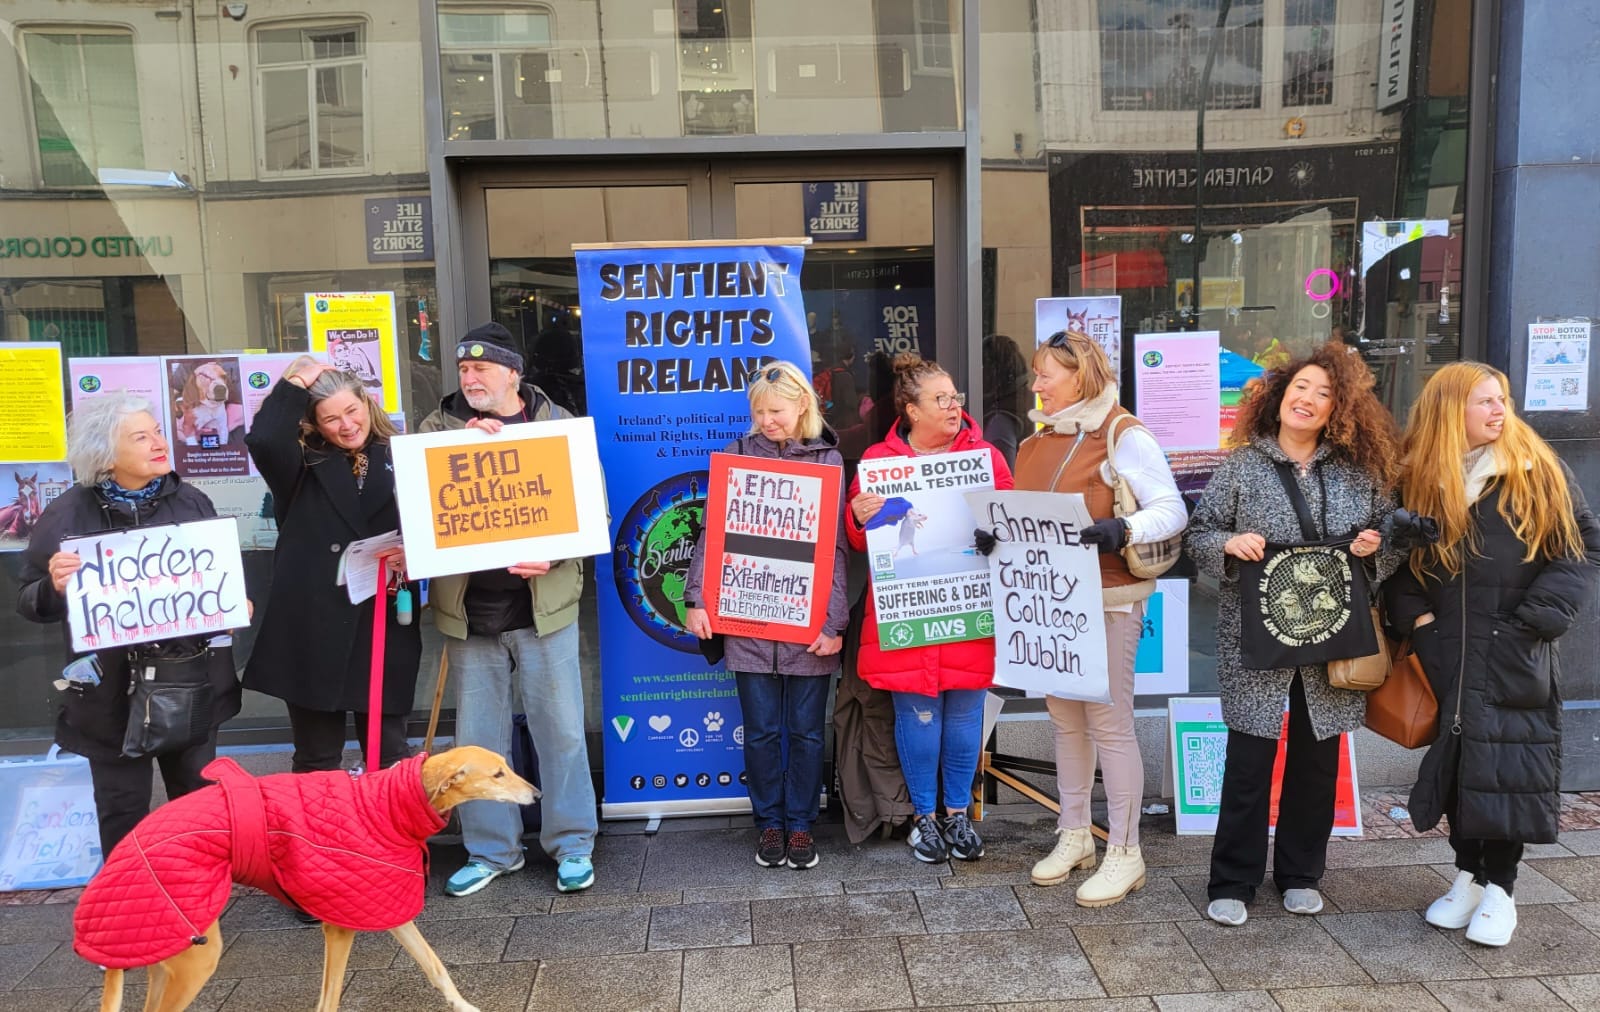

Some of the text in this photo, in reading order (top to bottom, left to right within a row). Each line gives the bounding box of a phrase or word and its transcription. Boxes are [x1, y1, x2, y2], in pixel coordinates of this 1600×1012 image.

[600, 261, 790, 301] SENTIENT
[625, 308, 775, 347] RIGHTS
[1093, 323, 1109, 333] GET
[617, 356, 779, 395] IRELAN
[618, 414, 672, 426] Ireland's
[676, 413, 724, 427] political
[613, 429, 744, 443] Animal Rights, Huma
[656, 447, 668, 458] &
[448, 449, 521, 483] END
[866, 457, 985, 483] STOP BOTOX
[45, 487, 62, 497] GET
[745, 473, 795, 500] END
[866, 472, 990, 495] ANIMAL TESTING
[74, 536, 216, 592] Hidden
[640, 534, 696, 579] Sentie
[1026, 549, 1050, 566] on
[1263, 549, 1292, 577] ANIMALS
[876, 583, 903, 593] SHORT
[907, 580, 929, 589] TERM
[969, 572, 991, 581] CAUS
[1259, 577, 1270, 593] ALL
[879, 582, 992, 610] SUFFERING & DEAT
[880, 600, 993, 621] FOR THOUSANDS OF MI
[1006, 591, 1089, 642] College
[1263, 618, 1280, 637] LIVE
[1311, 630, 1332, 645] LIVE
[1329, 608, 1352, 634] VEGAN
[1008, 630, 1086, 677] Dublin
[633, 669, 736, 684] www.sentientright
[620, 687, 738, 702] sentientrightsireland
